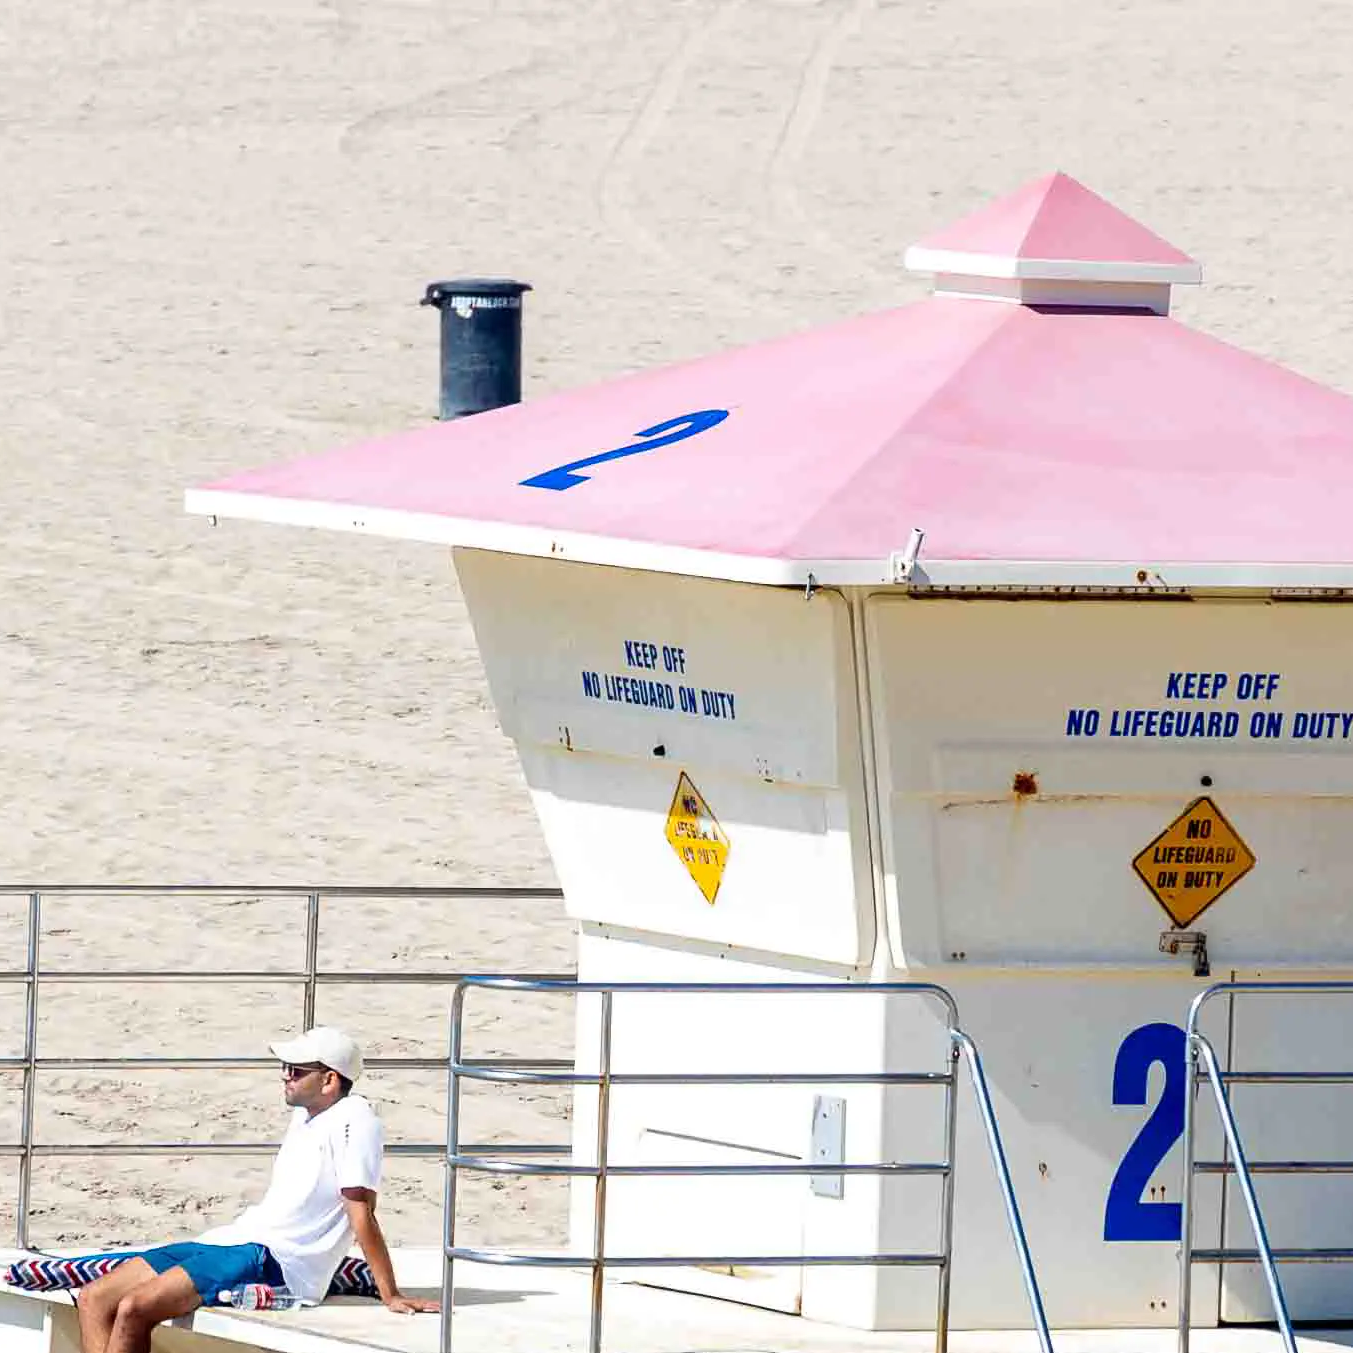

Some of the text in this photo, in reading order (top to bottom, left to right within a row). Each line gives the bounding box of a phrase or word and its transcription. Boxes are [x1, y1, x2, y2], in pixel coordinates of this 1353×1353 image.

[518, 409, 730, 491] 2
[624, 640, 686, 674] KEEP OFF
[582, 671, 736, 720] NO LIFEGUARD ON DUTY
[1166, 672, 1280, 700] KEEP OFF
[1066, 710, 1100, 737] NO
[1110, 711, 1239, 738] LIFEGUARD
[1249, 711, 1282, 738] ON
[1186, 819, 1212, 839] NO
[1153, 846, 1236, 864] LIFEGUARD
[1157, 871, 1224, 888] ON DUTY
[1103, 1023, 1187, 1241] 2
